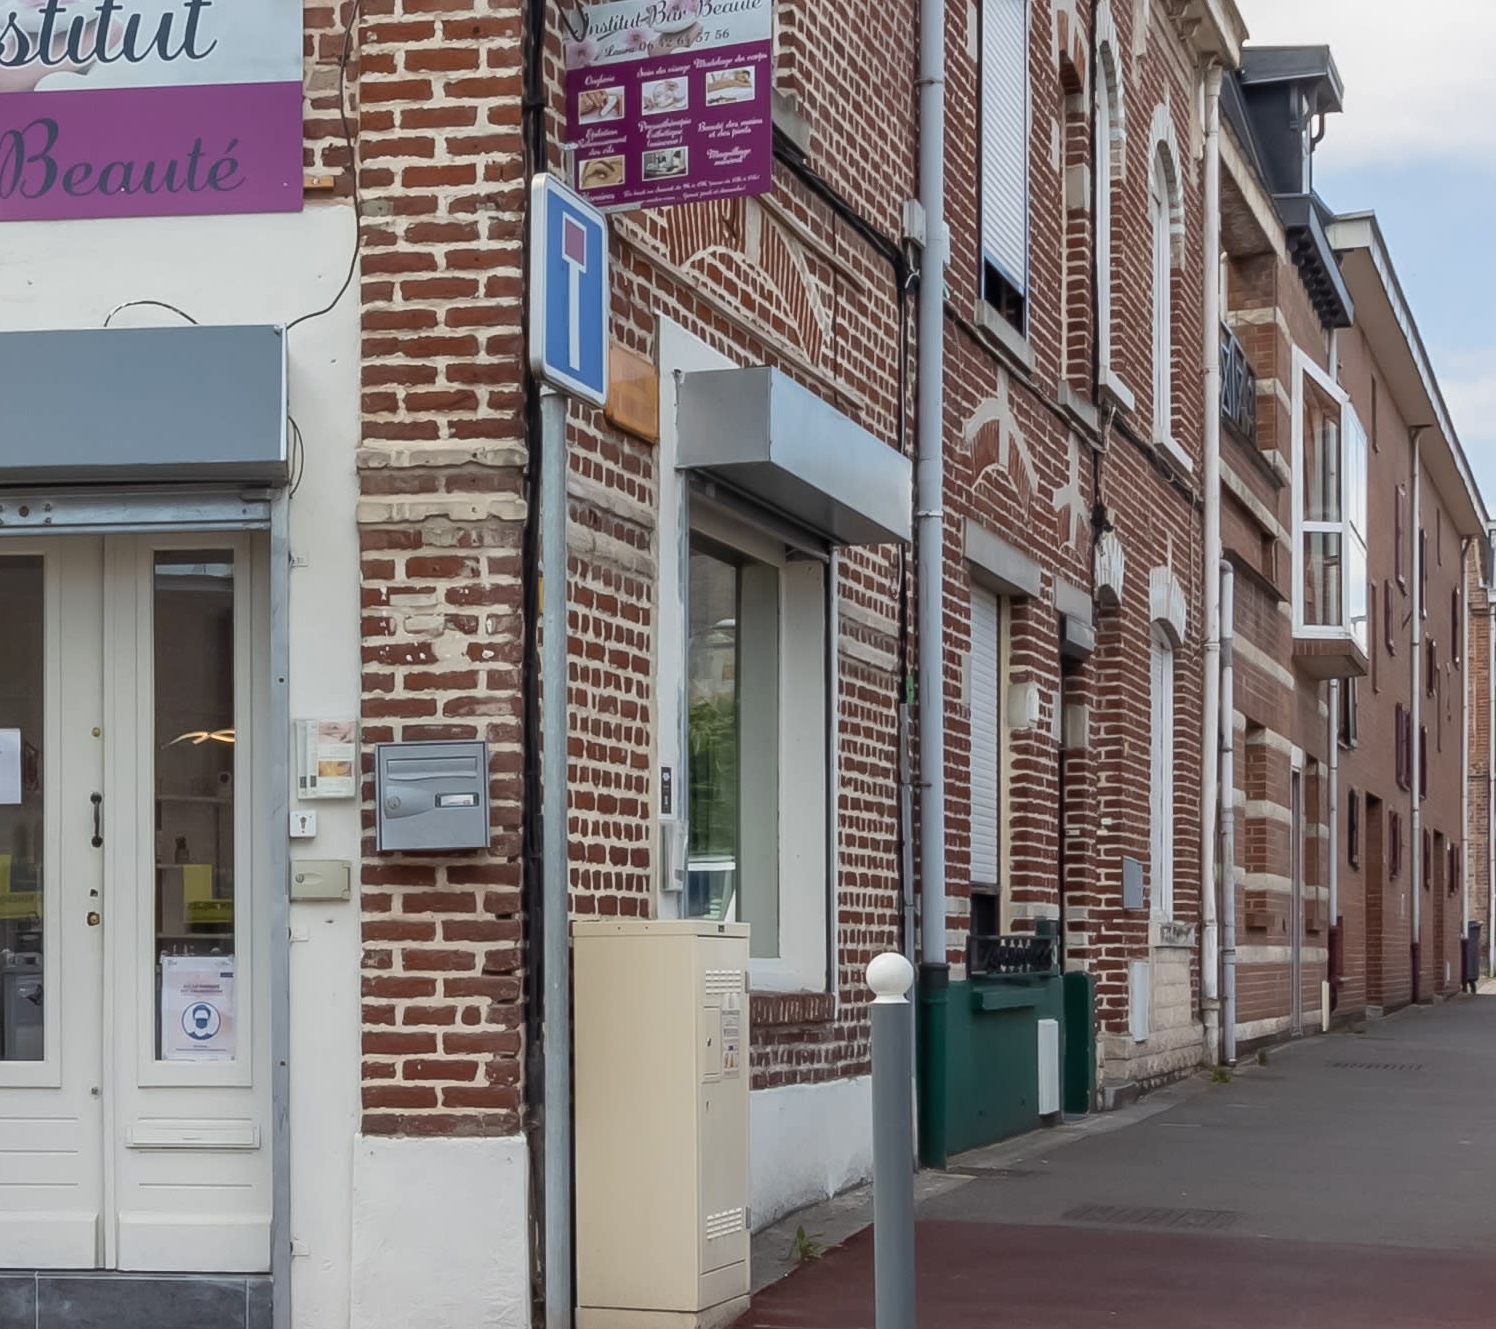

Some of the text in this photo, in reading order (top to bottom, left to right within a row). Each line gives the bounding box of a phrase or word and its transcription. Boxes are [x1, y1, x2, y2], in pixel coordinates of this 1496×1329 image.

[573, 11, 644, 42] Institut
[649, 0, 687, 24] Bar
[715, 28, 730, 40] 56
